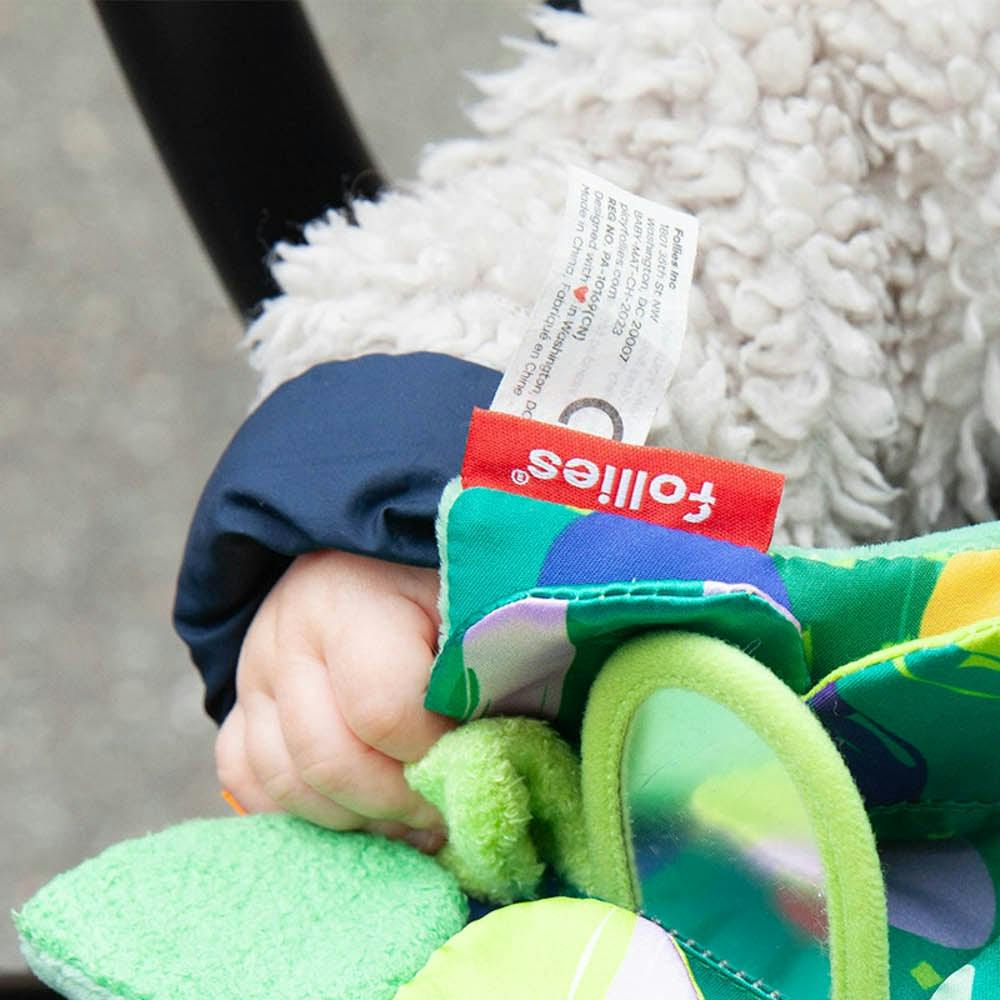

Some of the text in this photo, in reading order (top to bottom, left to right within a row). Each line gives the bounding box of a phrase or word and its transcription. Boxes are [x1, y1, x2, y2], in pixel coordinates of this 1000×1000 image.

[588, 190, 603, 250] Designed
[572, 196, 616, 342] REG NO. PA-10169(CN)
[580, 252, 593, 282] with
[611, 209, 642, 335] BABY-MAT-CH-2023
[669, 227, 683, 290] Follies Inc
[513, 183, 589, 396] Made in China, Fabriqué en Chine
[566, 305, 578, 317] in
[634, 296, 647, 318] DC
[649, 299, 660, 323] NW
[655, 280, 663, 296] St
[528, 319, 573, 395] Washington,
[619, 320, 641, 362] 20007
